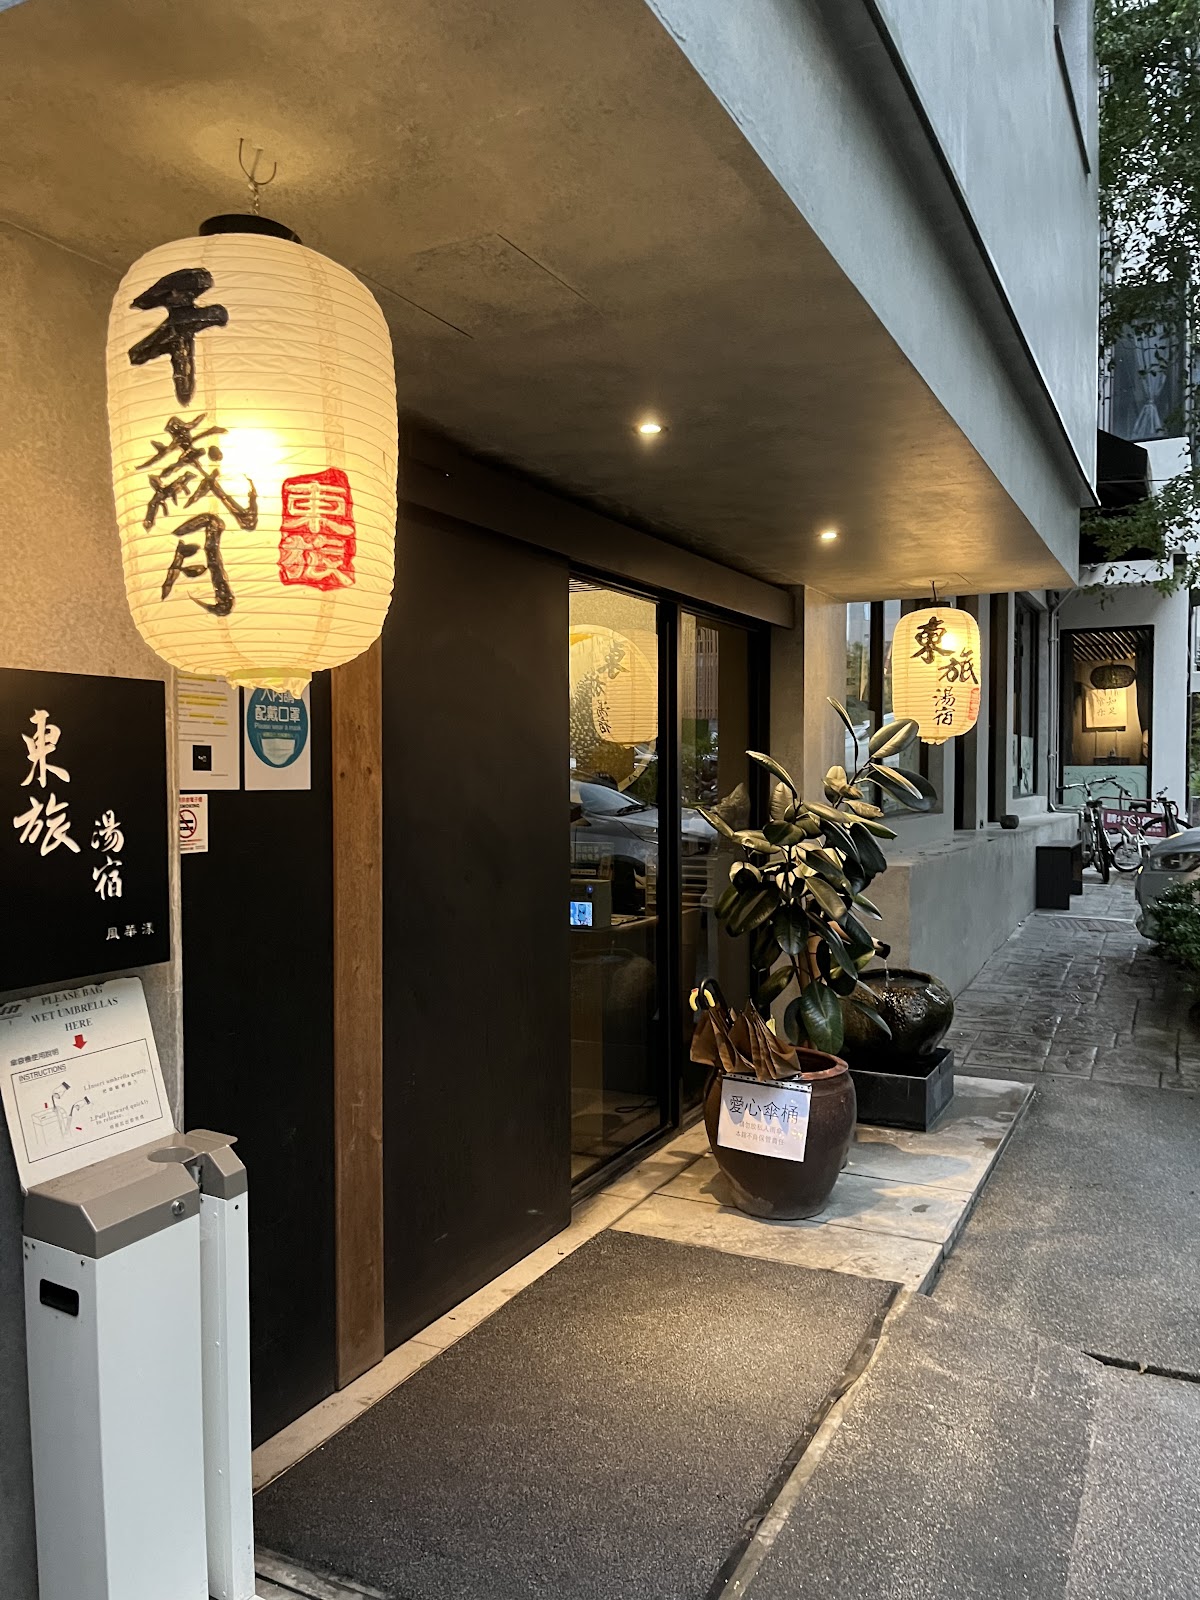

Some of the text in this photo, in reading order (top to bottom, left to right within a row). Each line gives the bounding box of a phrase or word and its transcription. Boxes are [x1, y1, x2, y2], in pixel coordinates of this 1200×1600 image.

[910, 616, 979, 685] 東旅
[255, 704, 301, 723] 配戴口罩
[932, 686, 956, 726] 湯宿
[13, 709, 81, 857] 東旅
[91, 809, 125, 901] 湯宿
[31, 996, 119, 1023] WET UMBRELLAS
[41, 985, 103, 1006] PLEASE BAG
[64, 1018, 93, 1032] HERE
[19, 1063, 67, 1082] INSTRUCTIONS
[729, 1095, 799, 1125] 愛心傘桶
